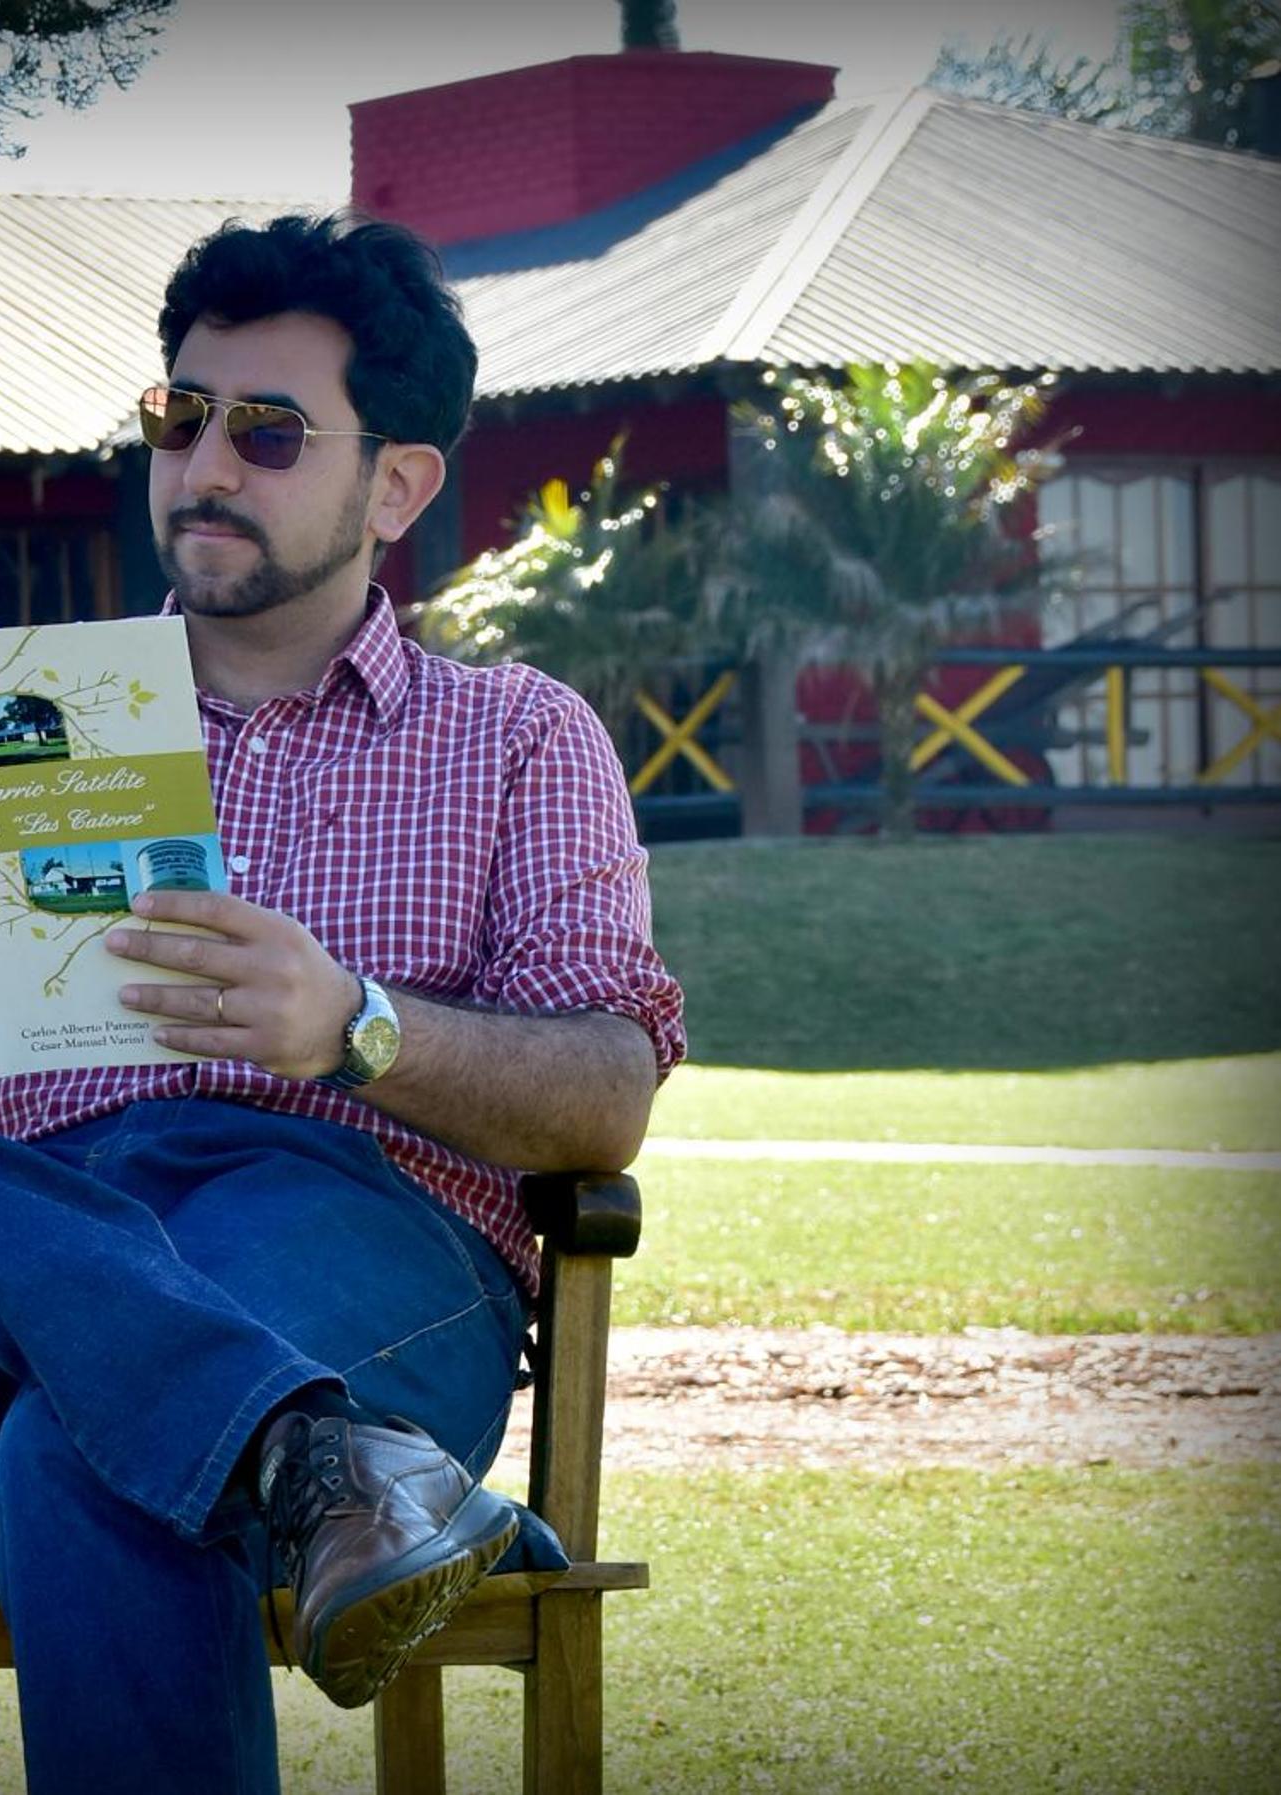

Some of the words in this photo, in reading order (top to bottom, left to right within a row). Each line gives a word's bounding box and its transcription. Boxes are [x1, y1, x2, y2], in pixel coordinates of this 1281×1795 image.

[21, 1027, 57, 1039] Carlos
[60, 1024, 103, 1035] Alberto
[31, 1040, 62, 1052] César
[65, 1036, 107, 1049] Manuel
